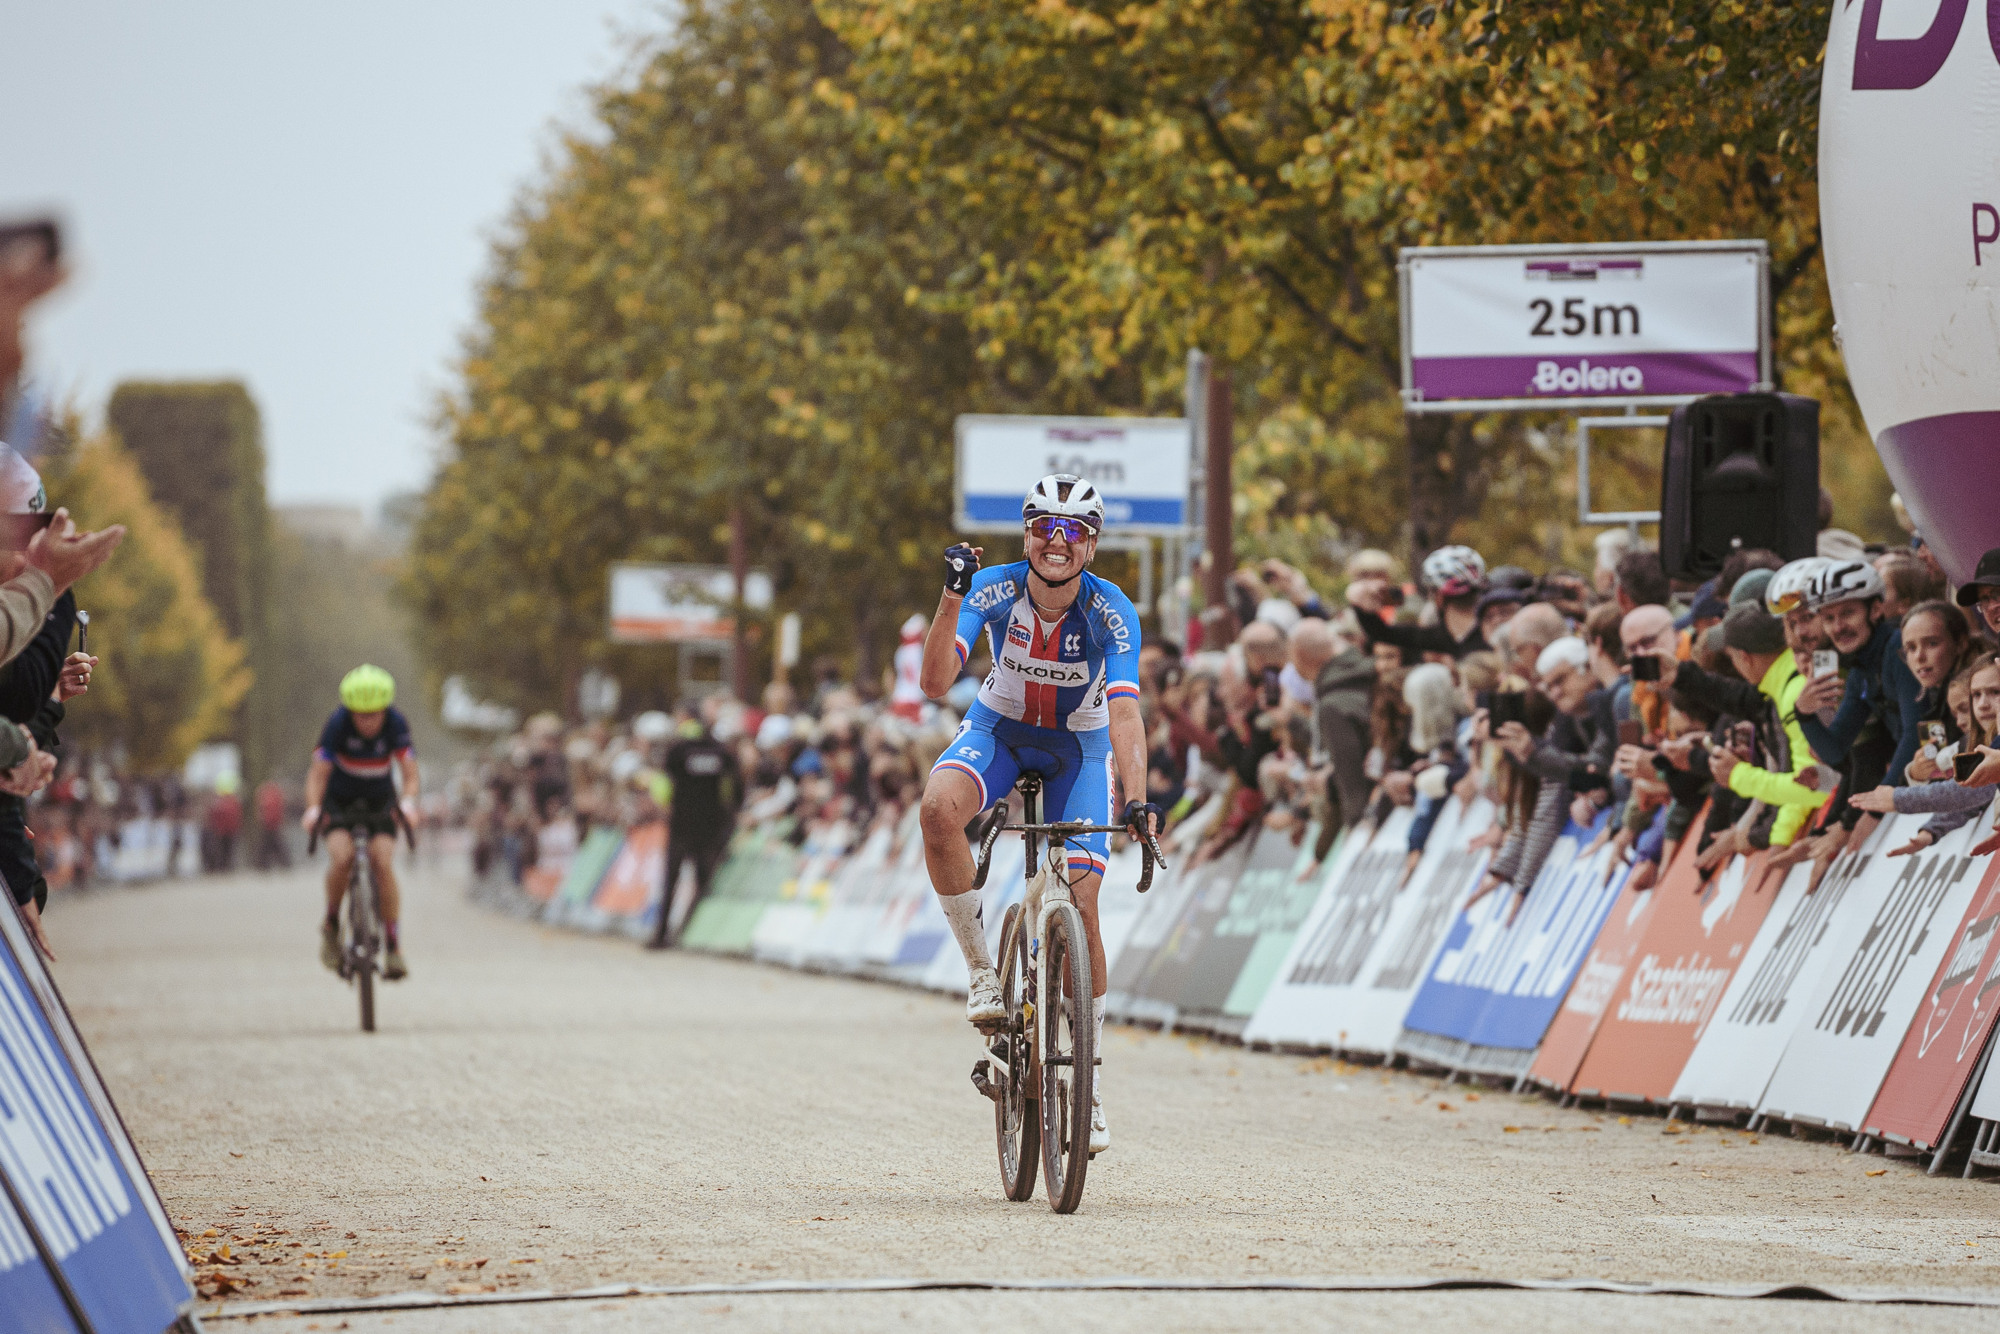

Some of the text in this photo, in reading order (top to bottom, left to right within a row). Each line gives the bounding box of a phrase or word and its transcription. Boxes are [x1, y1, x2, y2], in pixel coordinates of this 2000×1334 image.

[1530, 298, 1640, 336] 25m
[1532, 359, 1643, 391] Bolero
[1008, 626, 1031, 642] czech
[1008, 634, 1028, 650] team
[980, 825, 998, 858] SRAM
[1815, 852, 1974, 1038] ROSE
